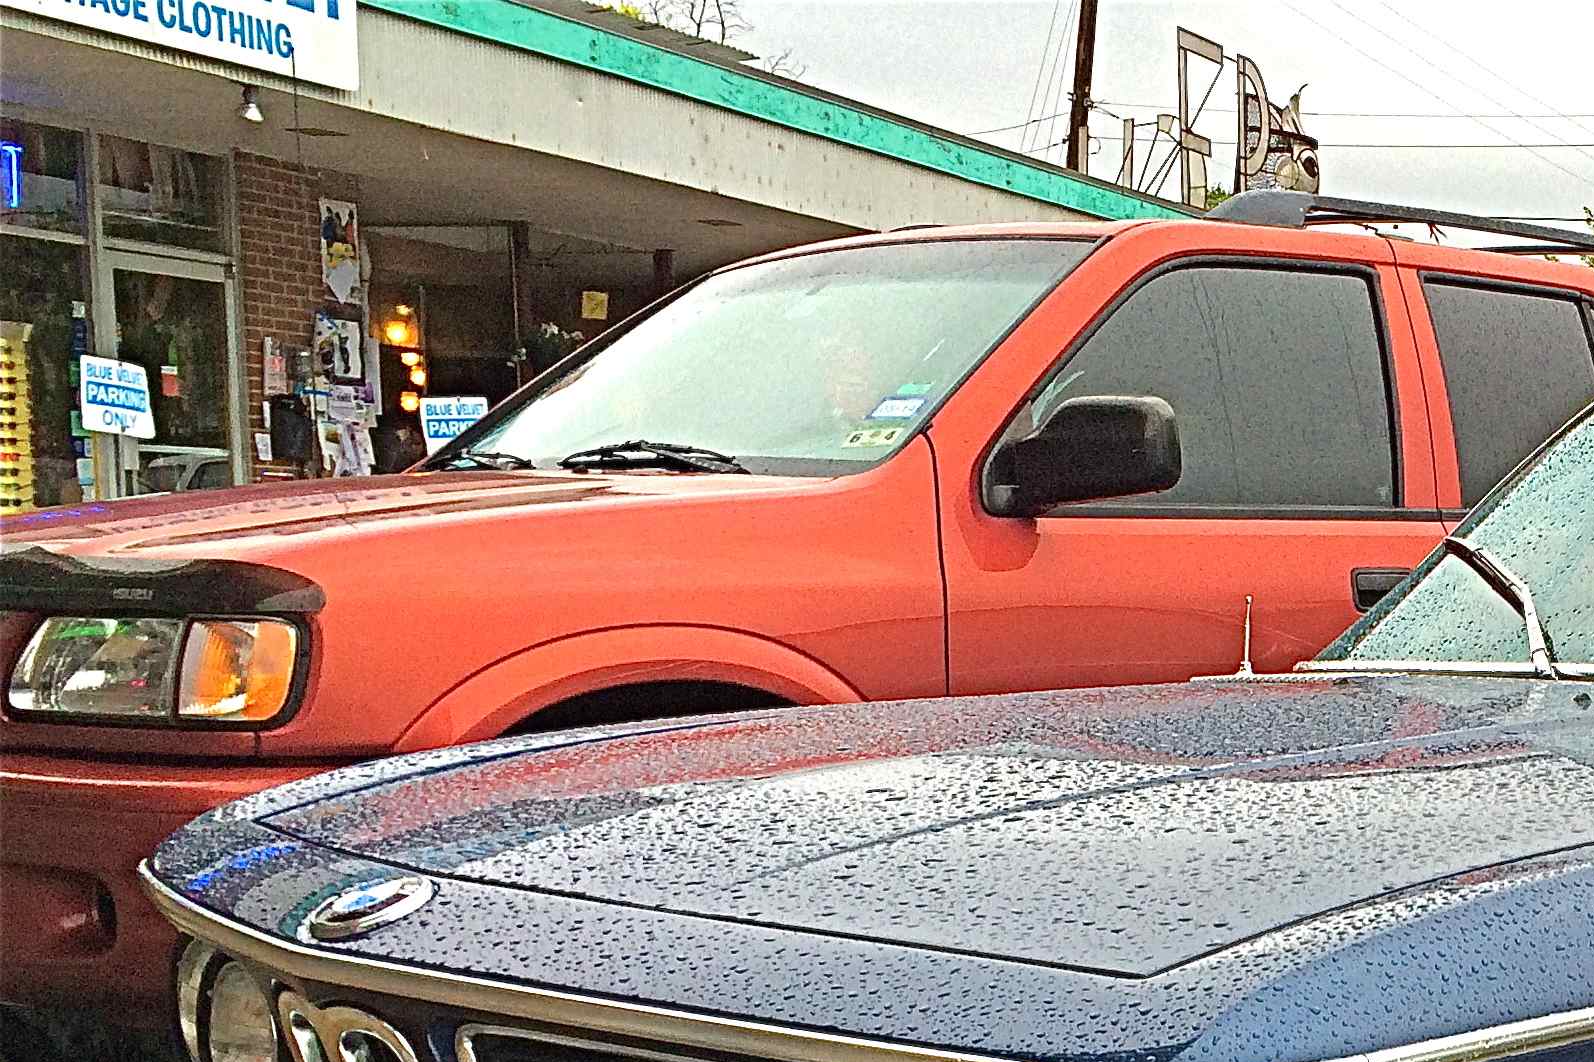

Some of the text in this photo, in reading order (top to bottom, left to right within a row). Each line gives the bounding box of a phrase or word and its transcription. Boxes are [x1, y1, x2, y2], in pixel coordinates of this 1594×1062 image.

[156, 0, 292, 58] CLOTHING
[86, 362, 113, 380] BLUE
[87, 383, 146, 409] PARKING
[102, 409, 137, 428] ONLY
[426, 404, 453, 416] BLUE
